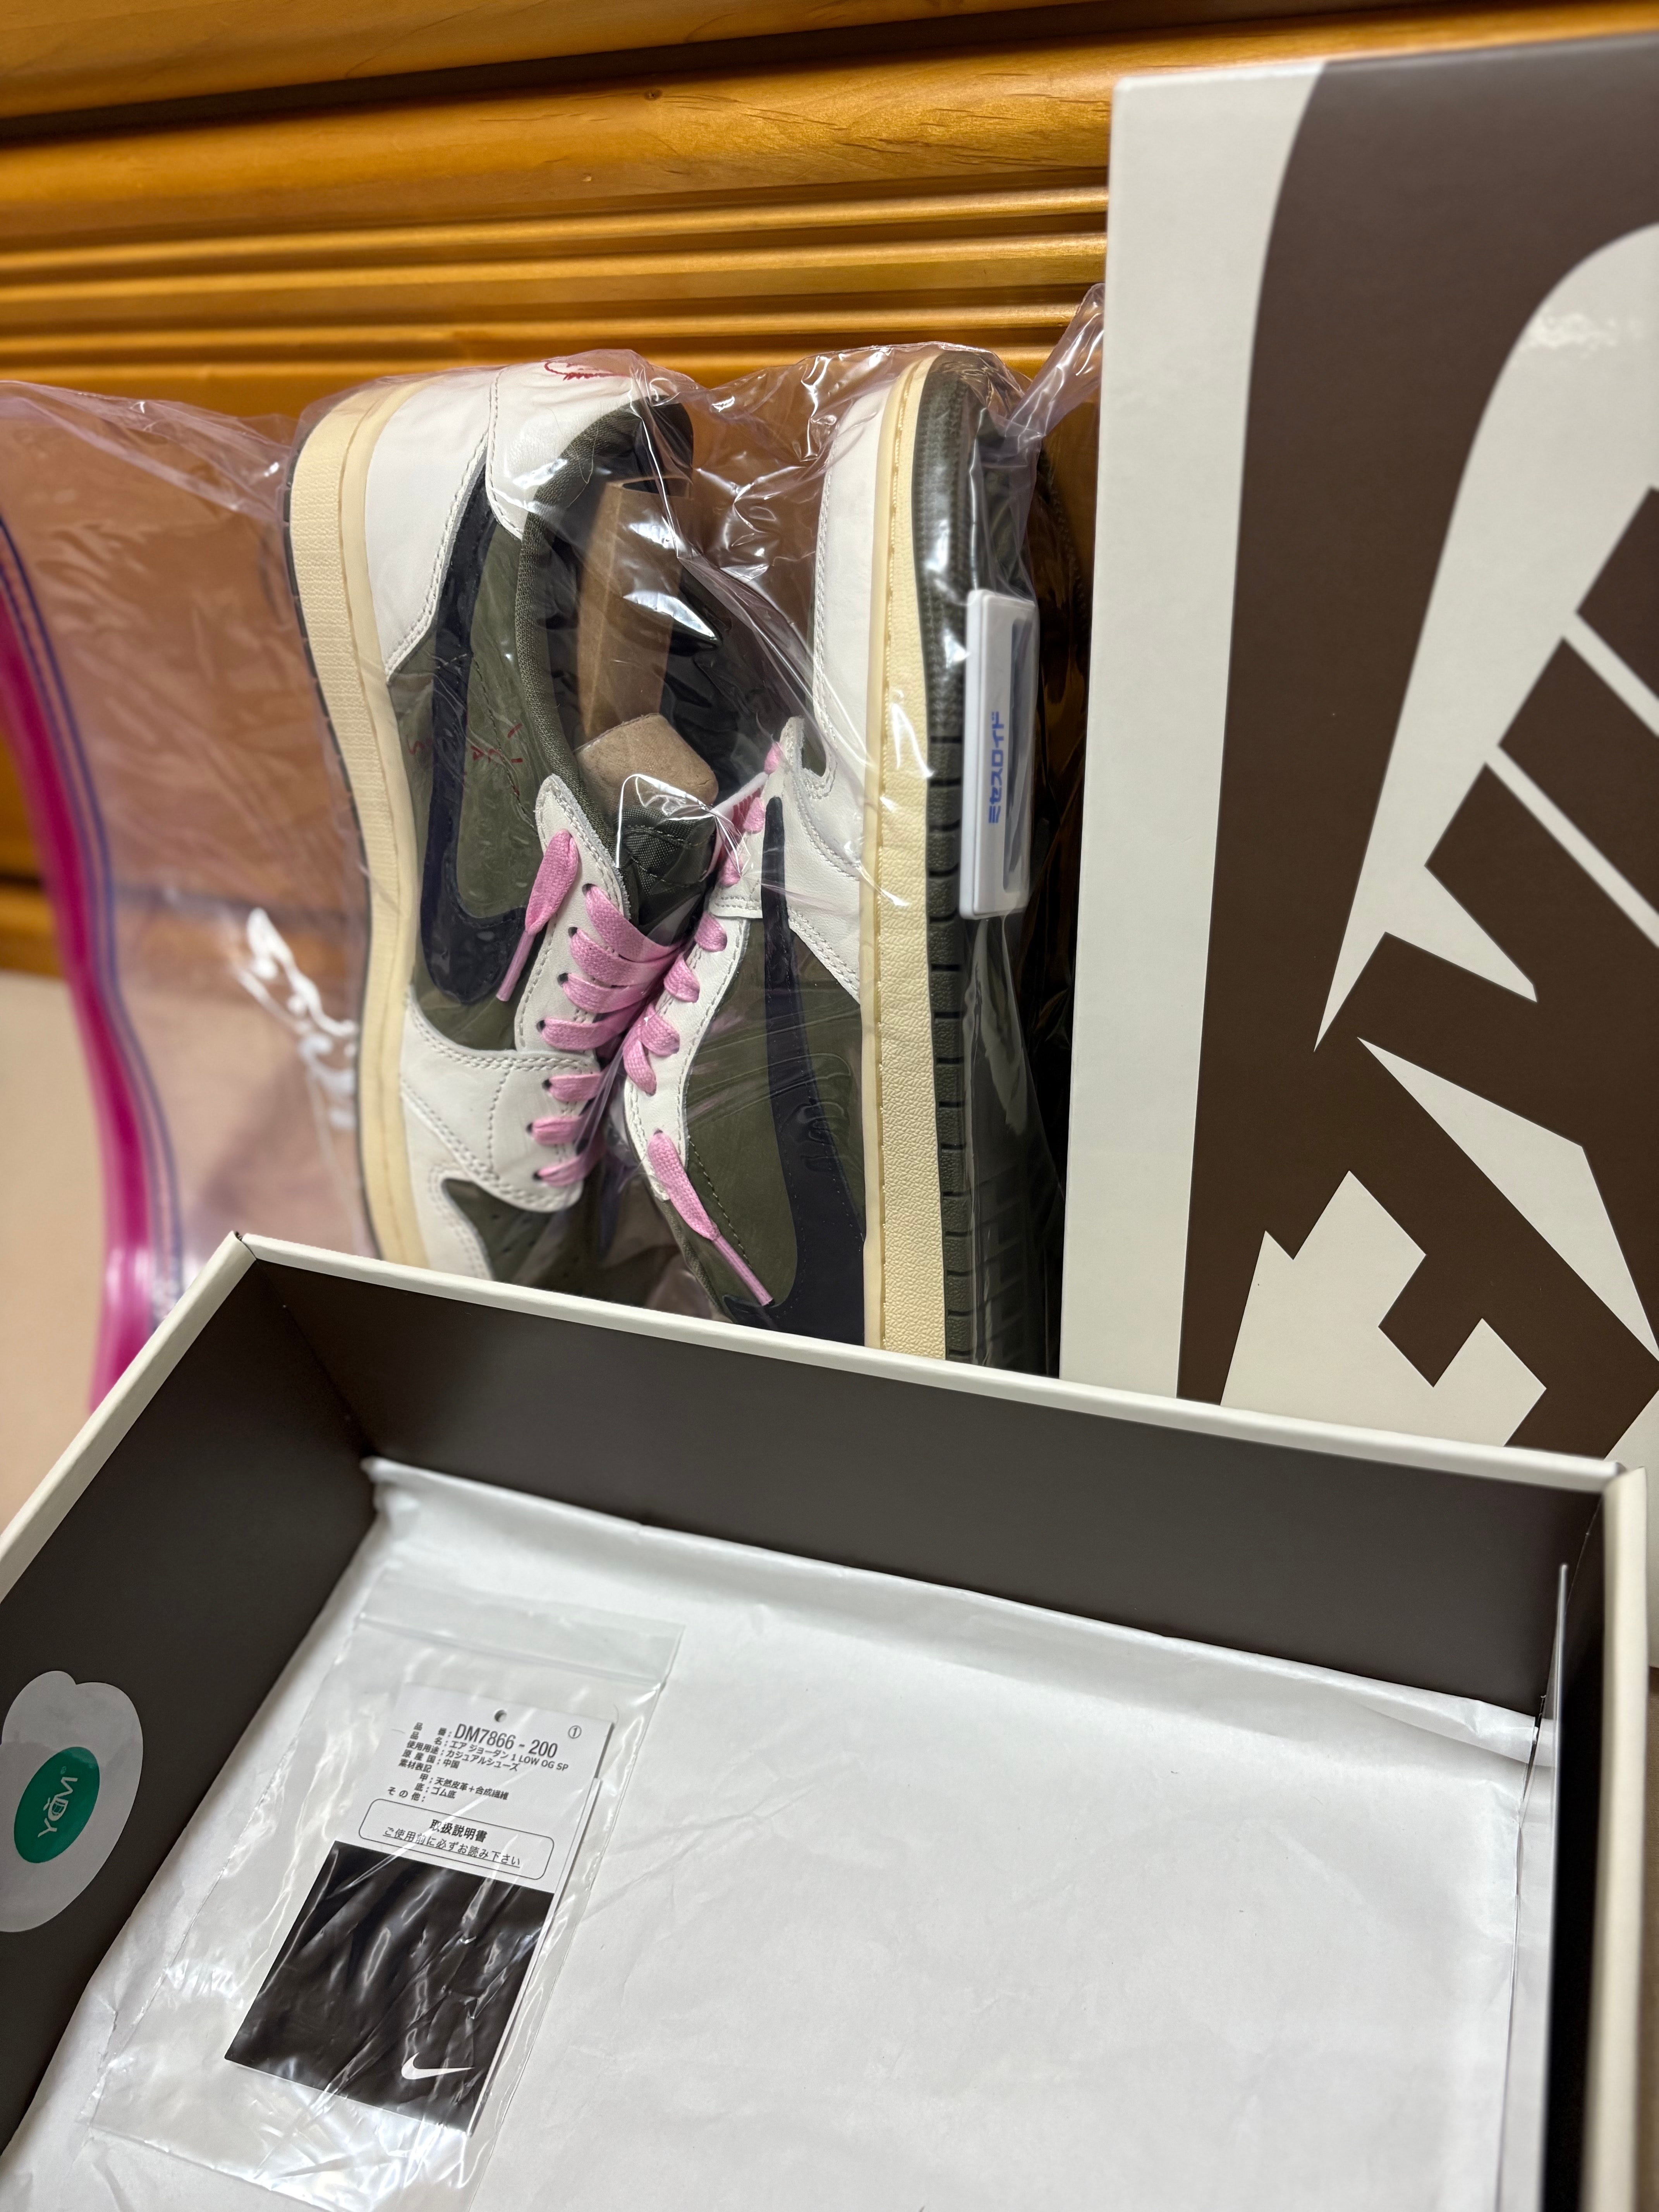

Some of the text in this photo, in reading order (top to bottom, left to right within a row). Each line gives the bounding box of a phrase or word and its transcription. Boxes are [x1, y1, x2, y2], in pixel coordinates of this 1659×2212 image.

[988, 711, 1004, 823] ミセスロイド
[398, 1758, 432, 1773] 素材表記
[519, 1755, 540, 1765] LOW
[542, 1760, 555, 1769] OG
[556, 1762, 569, 1771] SP
[429, 1819, 488, 1843] 取扱説明書
[385, 1827, 520, 1865] ご使用前に必ずお読み下さい
